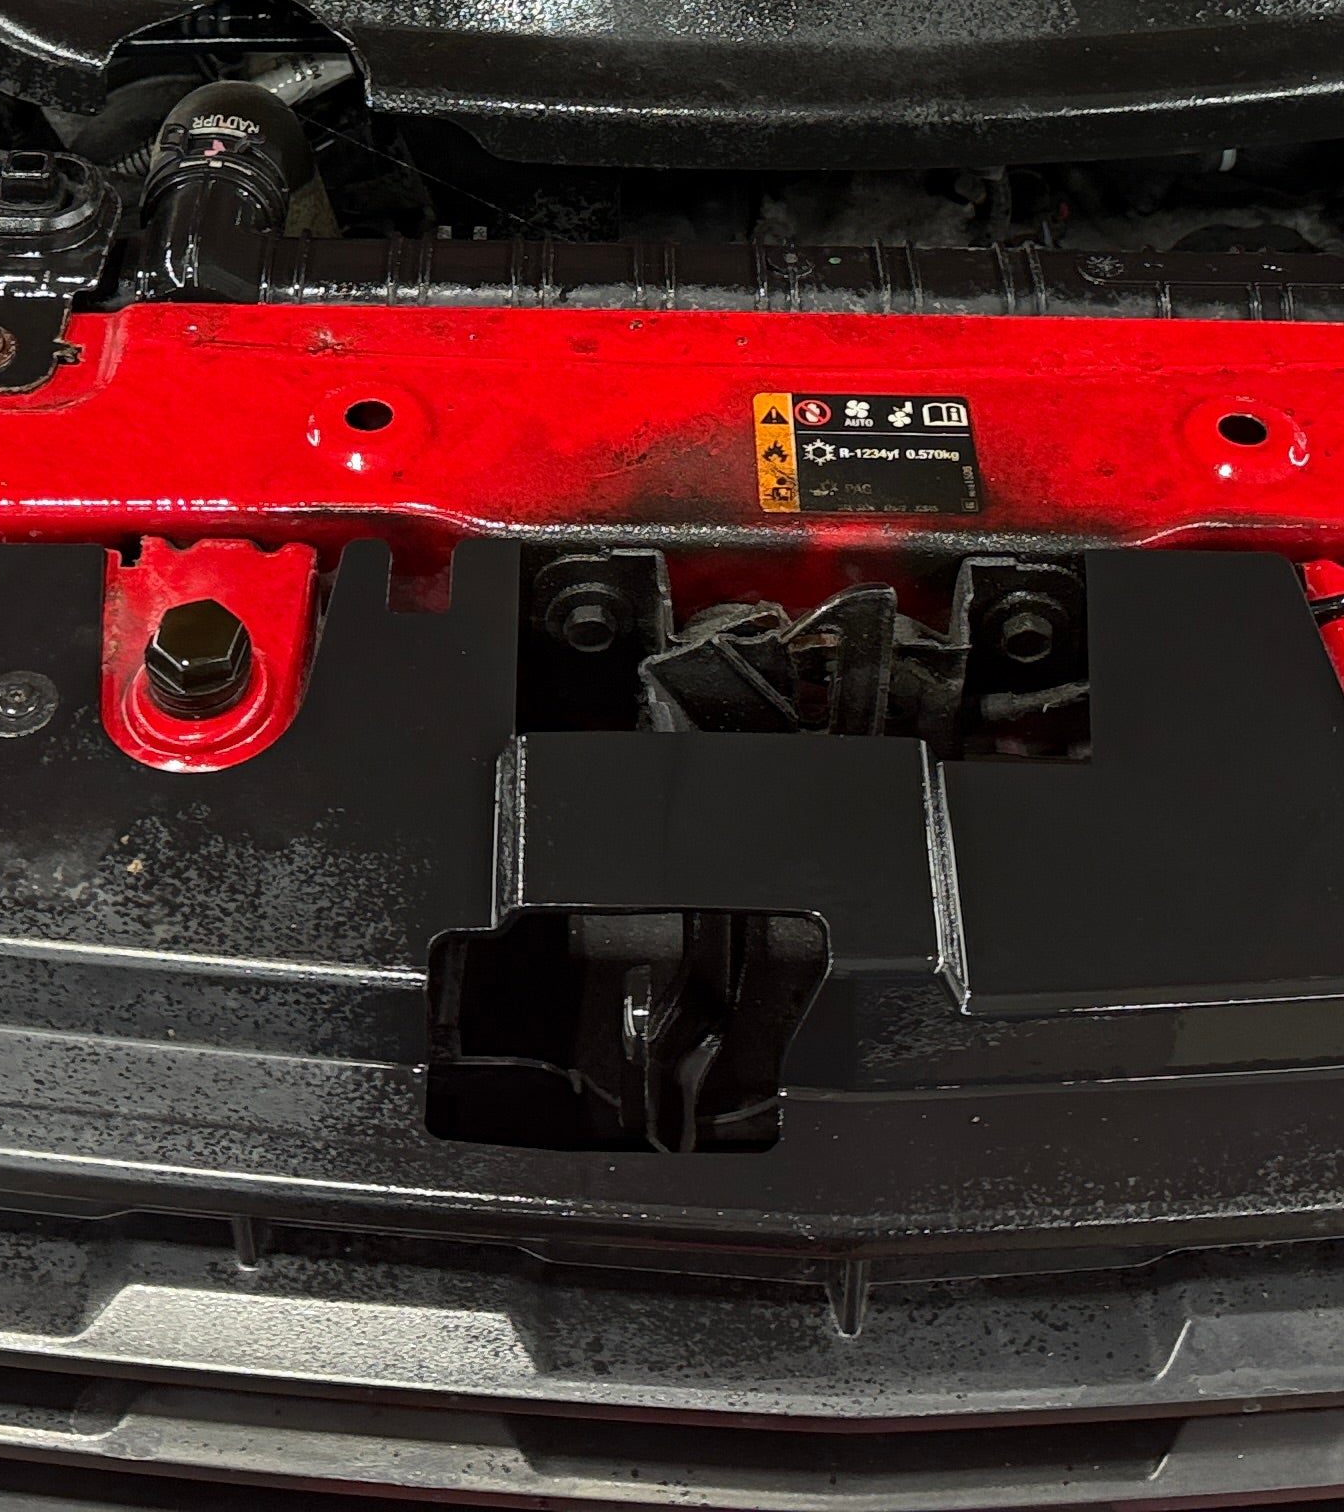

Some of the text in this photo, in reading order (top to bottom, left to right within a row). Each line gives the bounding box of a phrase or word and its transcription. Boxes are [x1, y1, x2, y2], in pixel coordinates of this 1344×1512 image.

[843, 418, 875, 428] AUTO
[838, 447, 961, 462] R-1234yf 0.570kg
